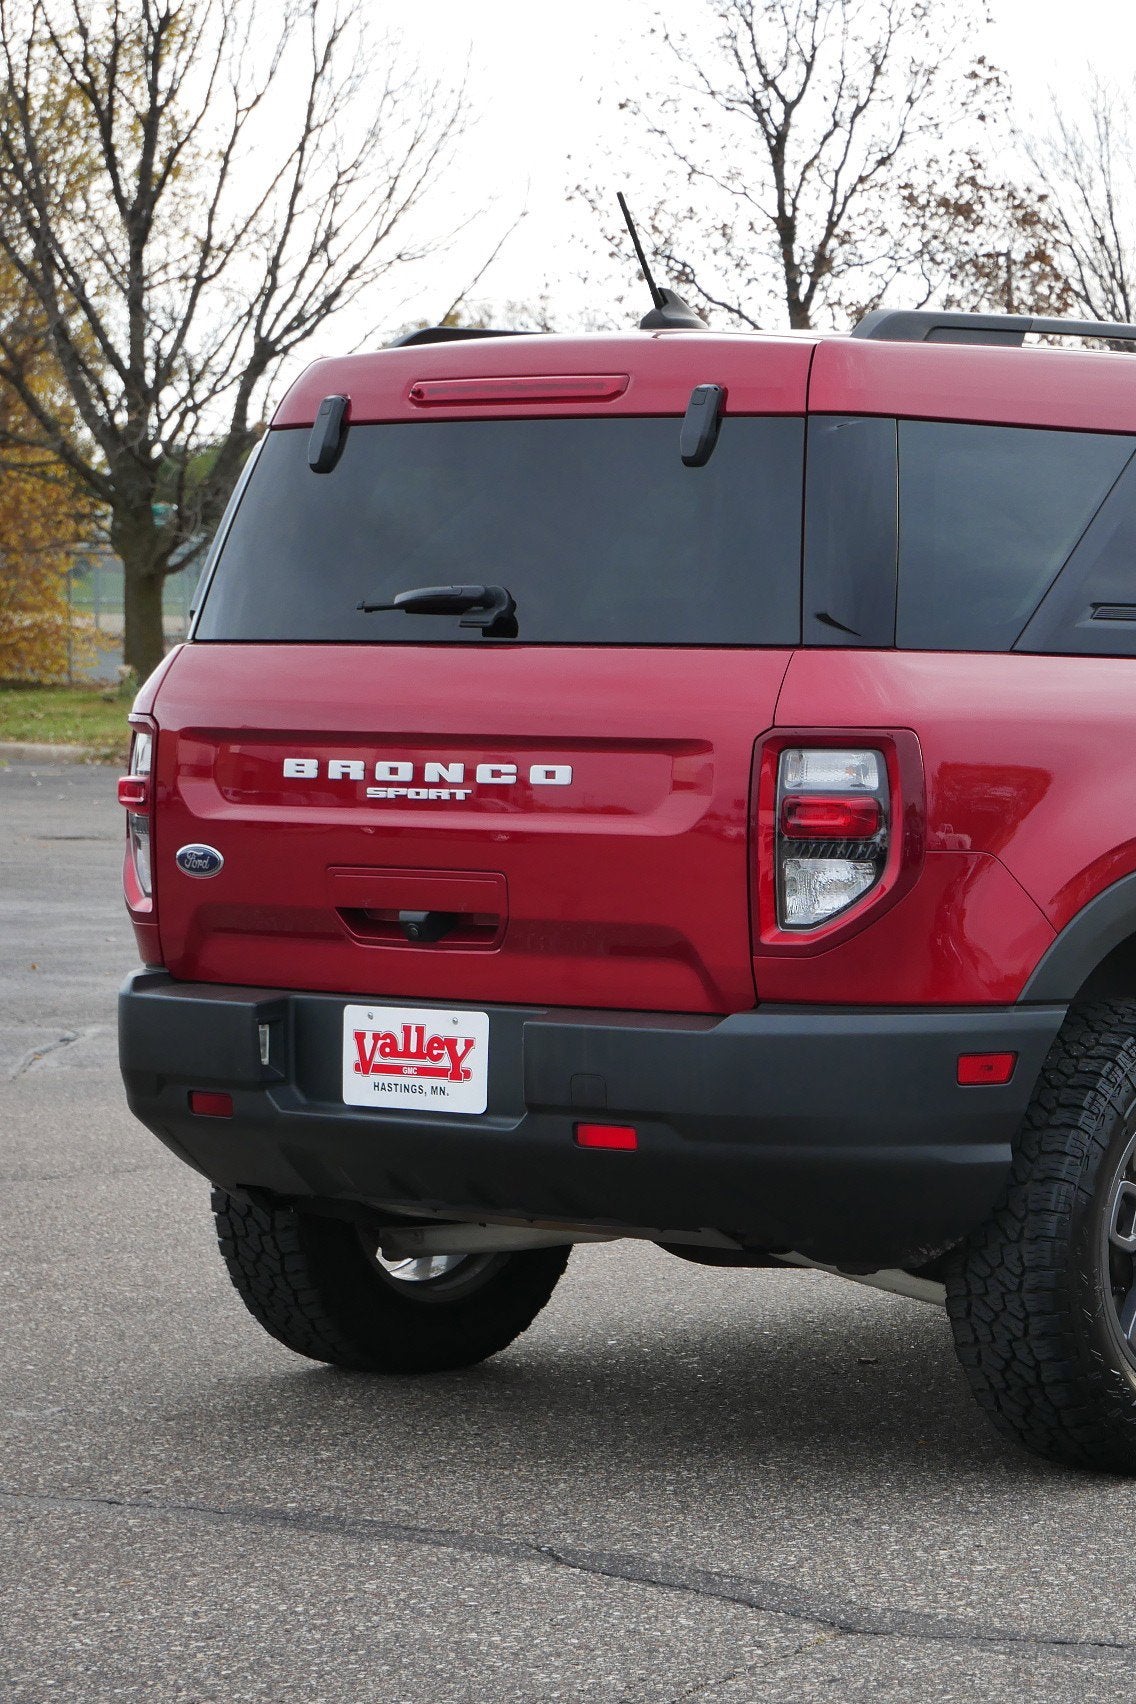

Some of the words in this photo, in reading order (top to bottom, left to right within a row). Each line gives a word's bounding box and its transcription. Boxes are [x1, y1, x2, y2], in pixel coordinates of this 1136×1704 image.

[283, 758, 572, 785] BRONCO
[366, 787, 472, 800] SPORT
[184, 850, 211, 869] Ford
[373, 1081, 427, 1096] HASTINGS,
[430, 1085, 450, 1096] MN.
